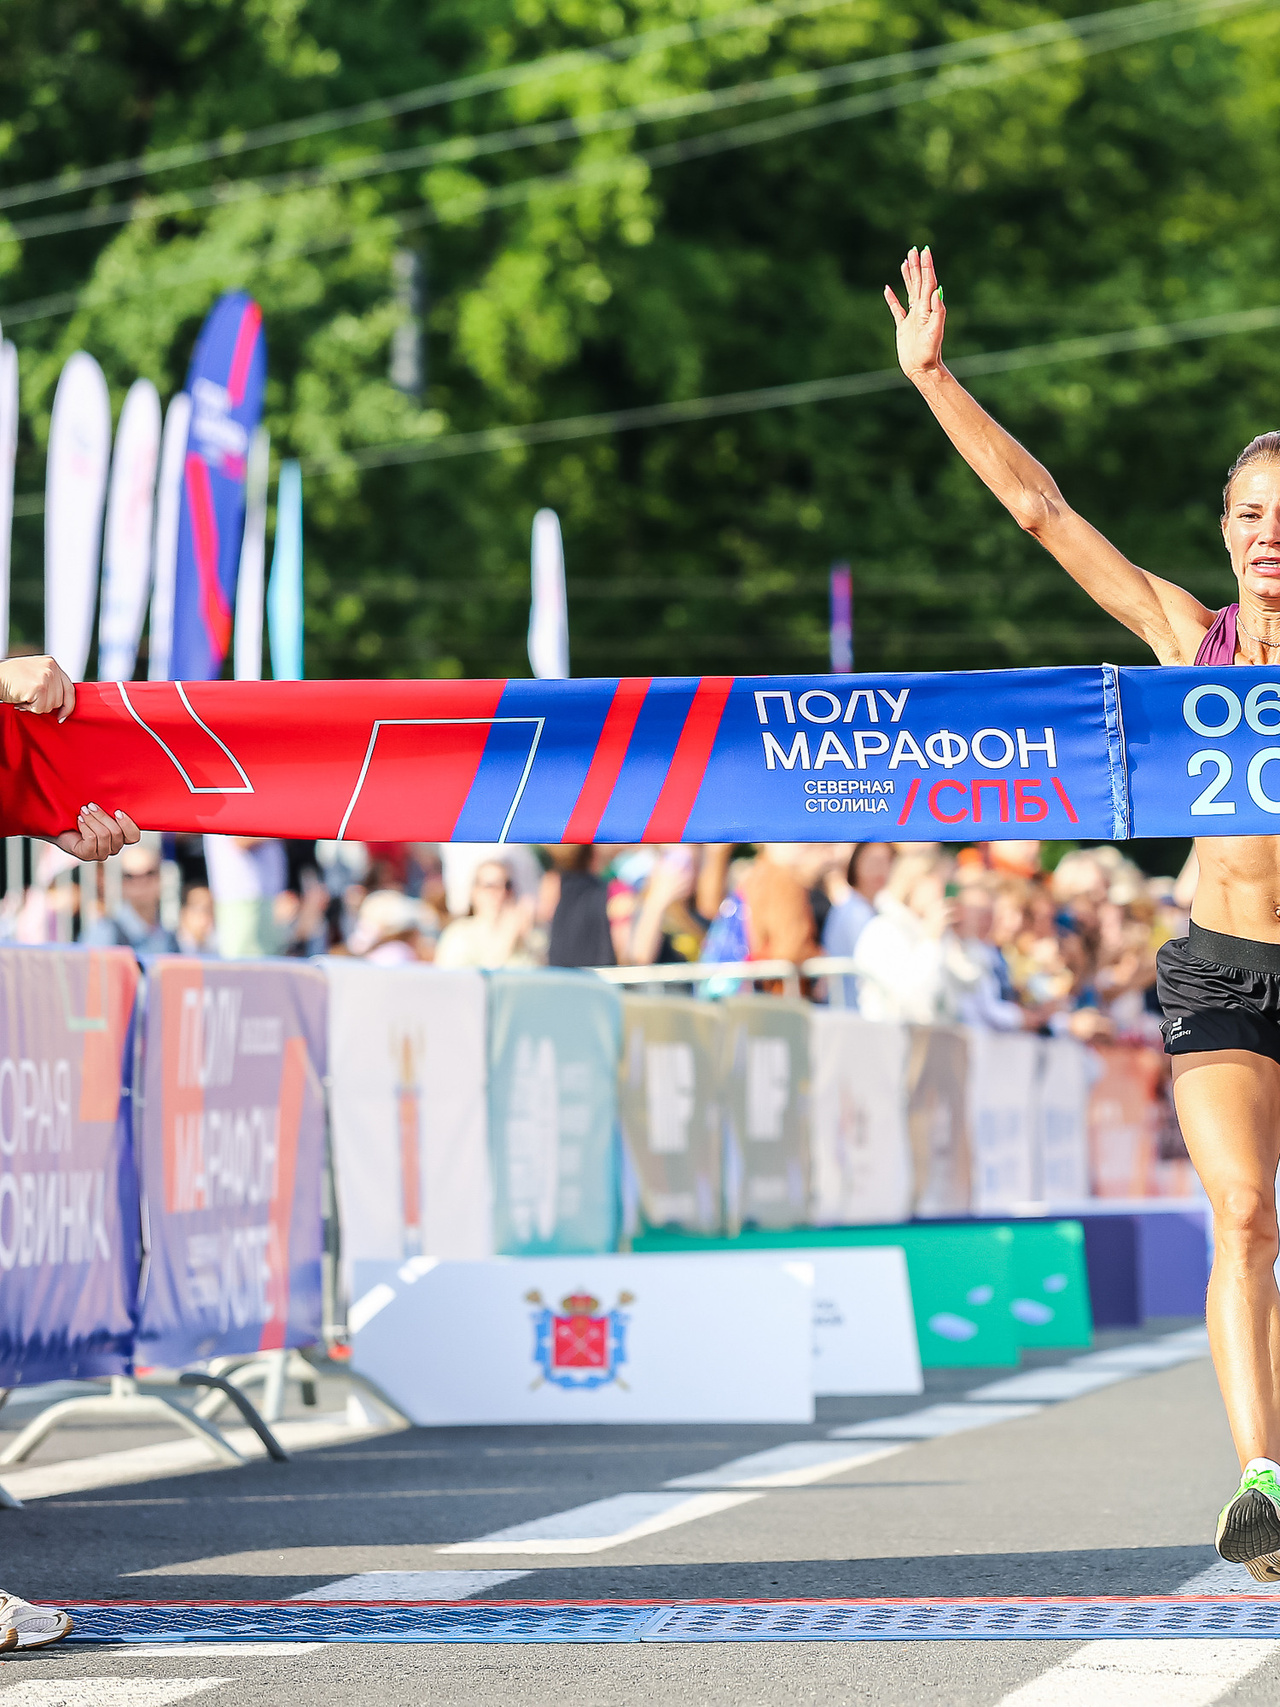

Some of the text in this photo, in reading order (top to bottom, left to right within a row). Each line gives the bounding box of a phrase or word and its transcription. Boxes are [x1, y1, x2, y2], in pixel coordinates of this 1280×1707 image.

[753, 688, 910, 724] ПОЛУ
[761, 727, 1058, 770] МАРАФОН
[804, 780, 894, 795] СЕВЕРНАЯ
[805, 798, 889, 814] СТОЛИЦА
[0, 1059, 72, 1154] ОРАЯ
[0, 1171, 111, 1269] ОВИНКА
